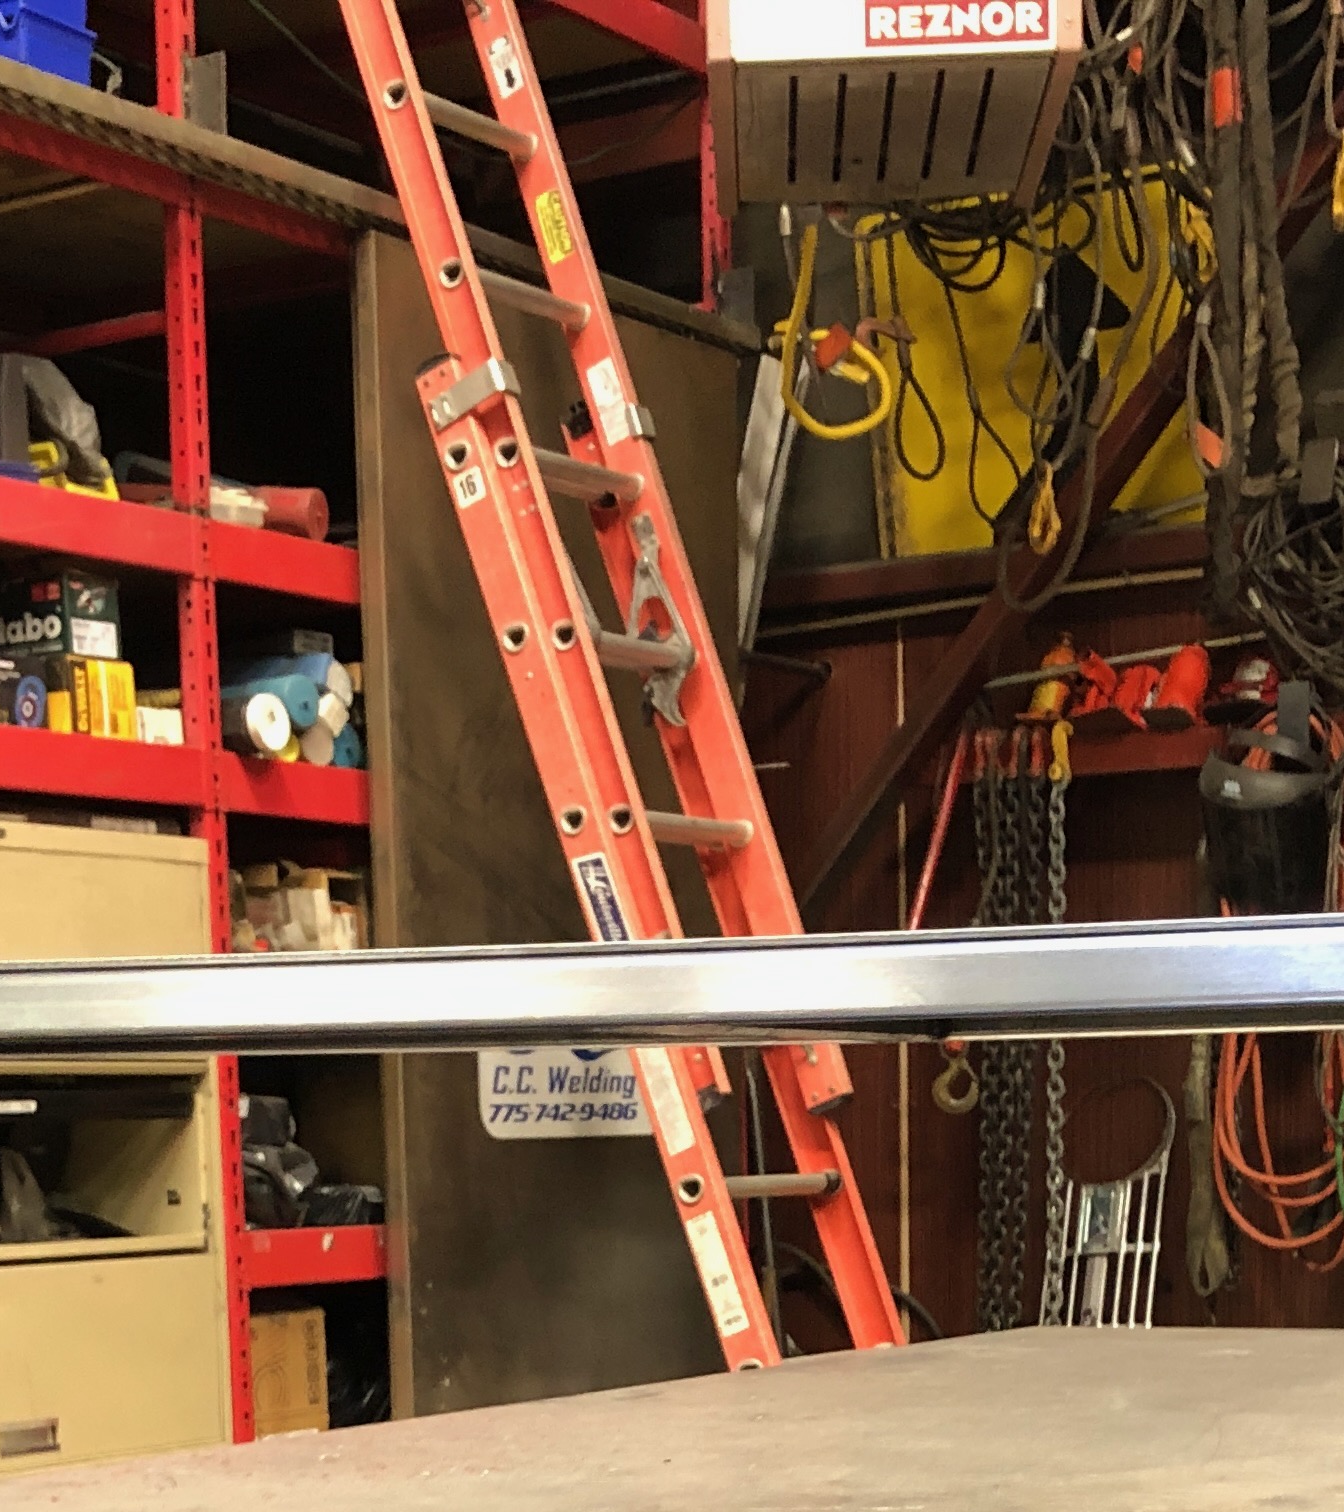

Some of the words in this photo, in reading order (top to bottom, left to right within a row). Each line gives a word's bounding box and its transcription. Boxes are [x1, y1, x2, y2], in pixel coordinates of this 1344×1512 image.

[868, 1, 1045, 40] REZNOR
[459, 474, 478, 499] 16
[492, 1065, 537, 1095] C.C.
[548, 1065, 637, 1099] Welding
[488, 1102, 639, 1123] 775-742-9486
